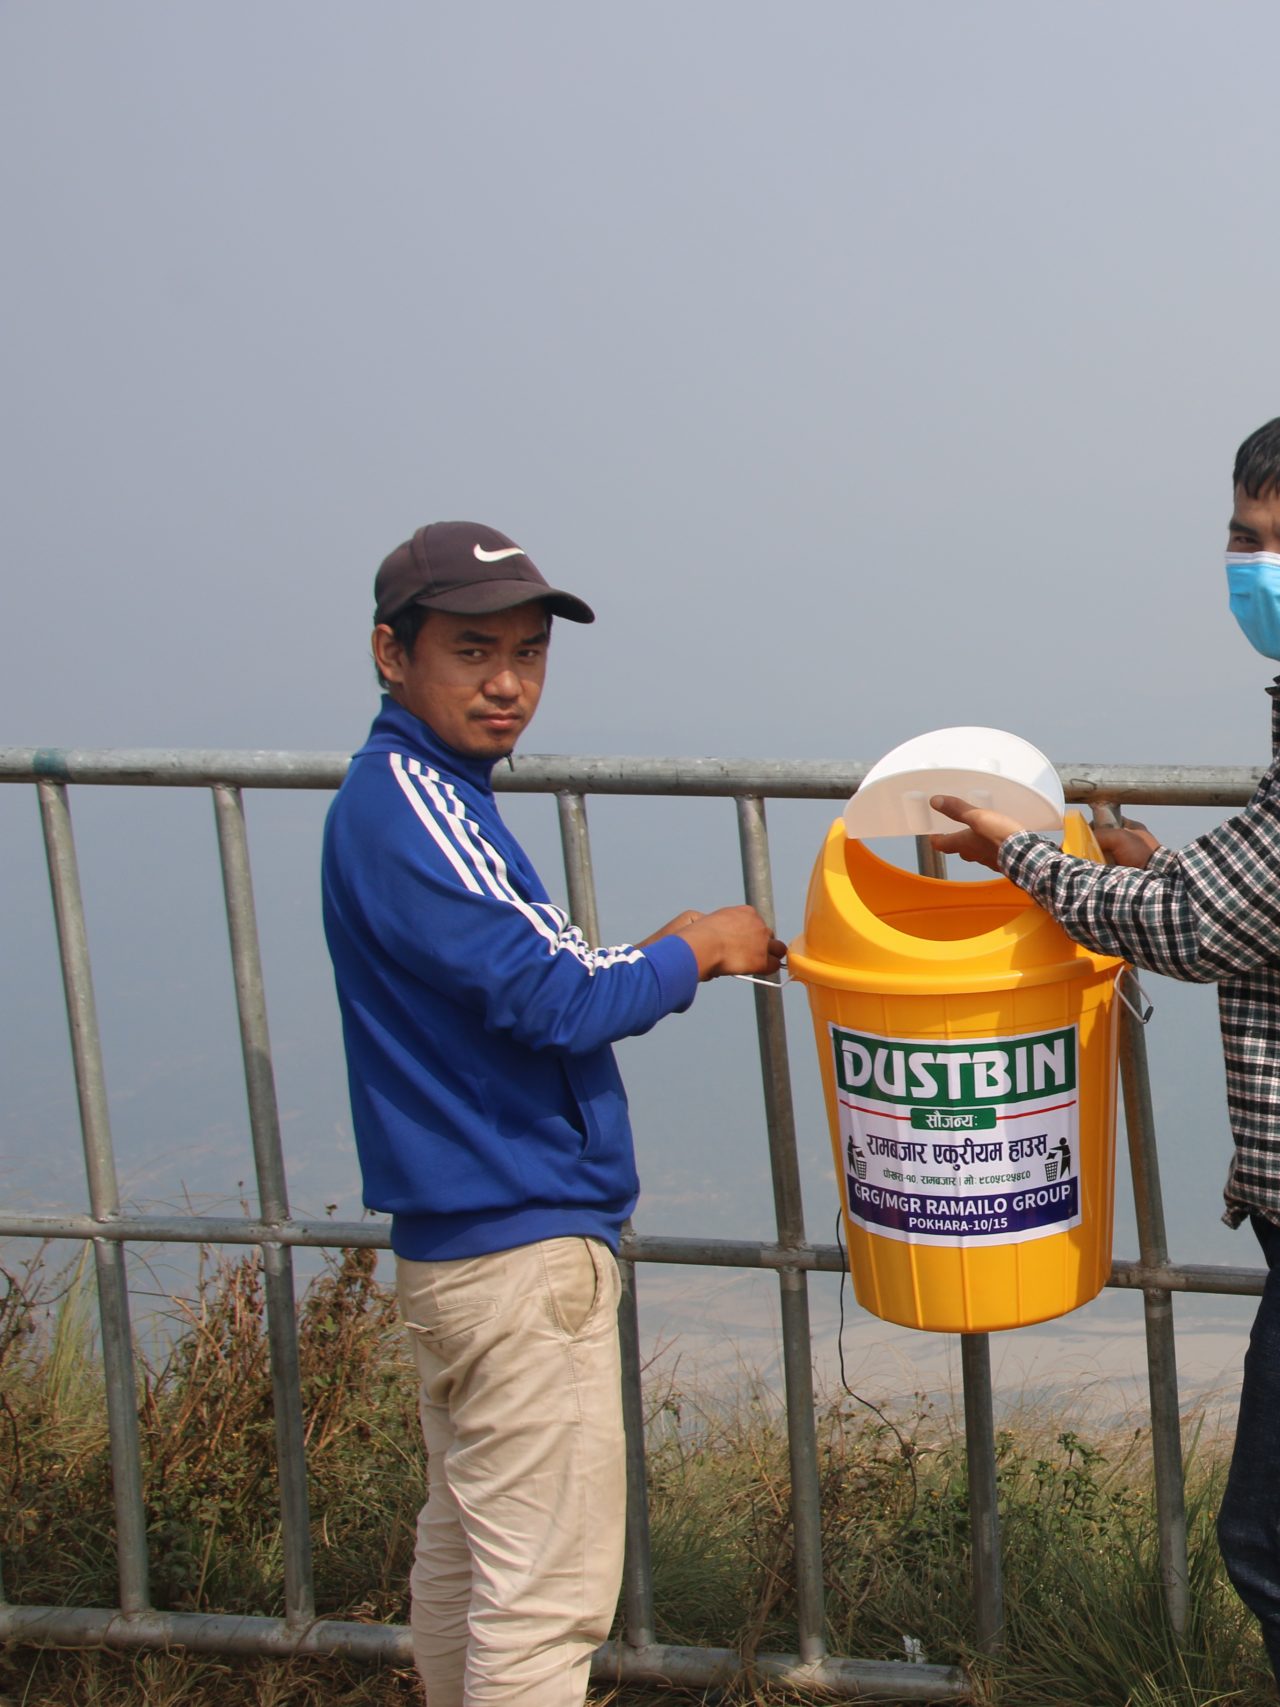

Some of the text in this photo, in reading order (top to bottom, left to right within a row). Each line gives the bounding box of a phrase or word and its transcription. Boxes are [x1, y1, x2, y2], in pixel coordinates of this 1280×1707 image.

[841, 1038, 1066, 1100] DUSTBIN
[866, 1134, 1048, 1171] रामबजार एकुरीयम हाउस
[854, 1182, 1071, 1216] GRG/MGR RAMAILO GROUP
[908, 1216, 1008, 1231] POKHARA-10/15
